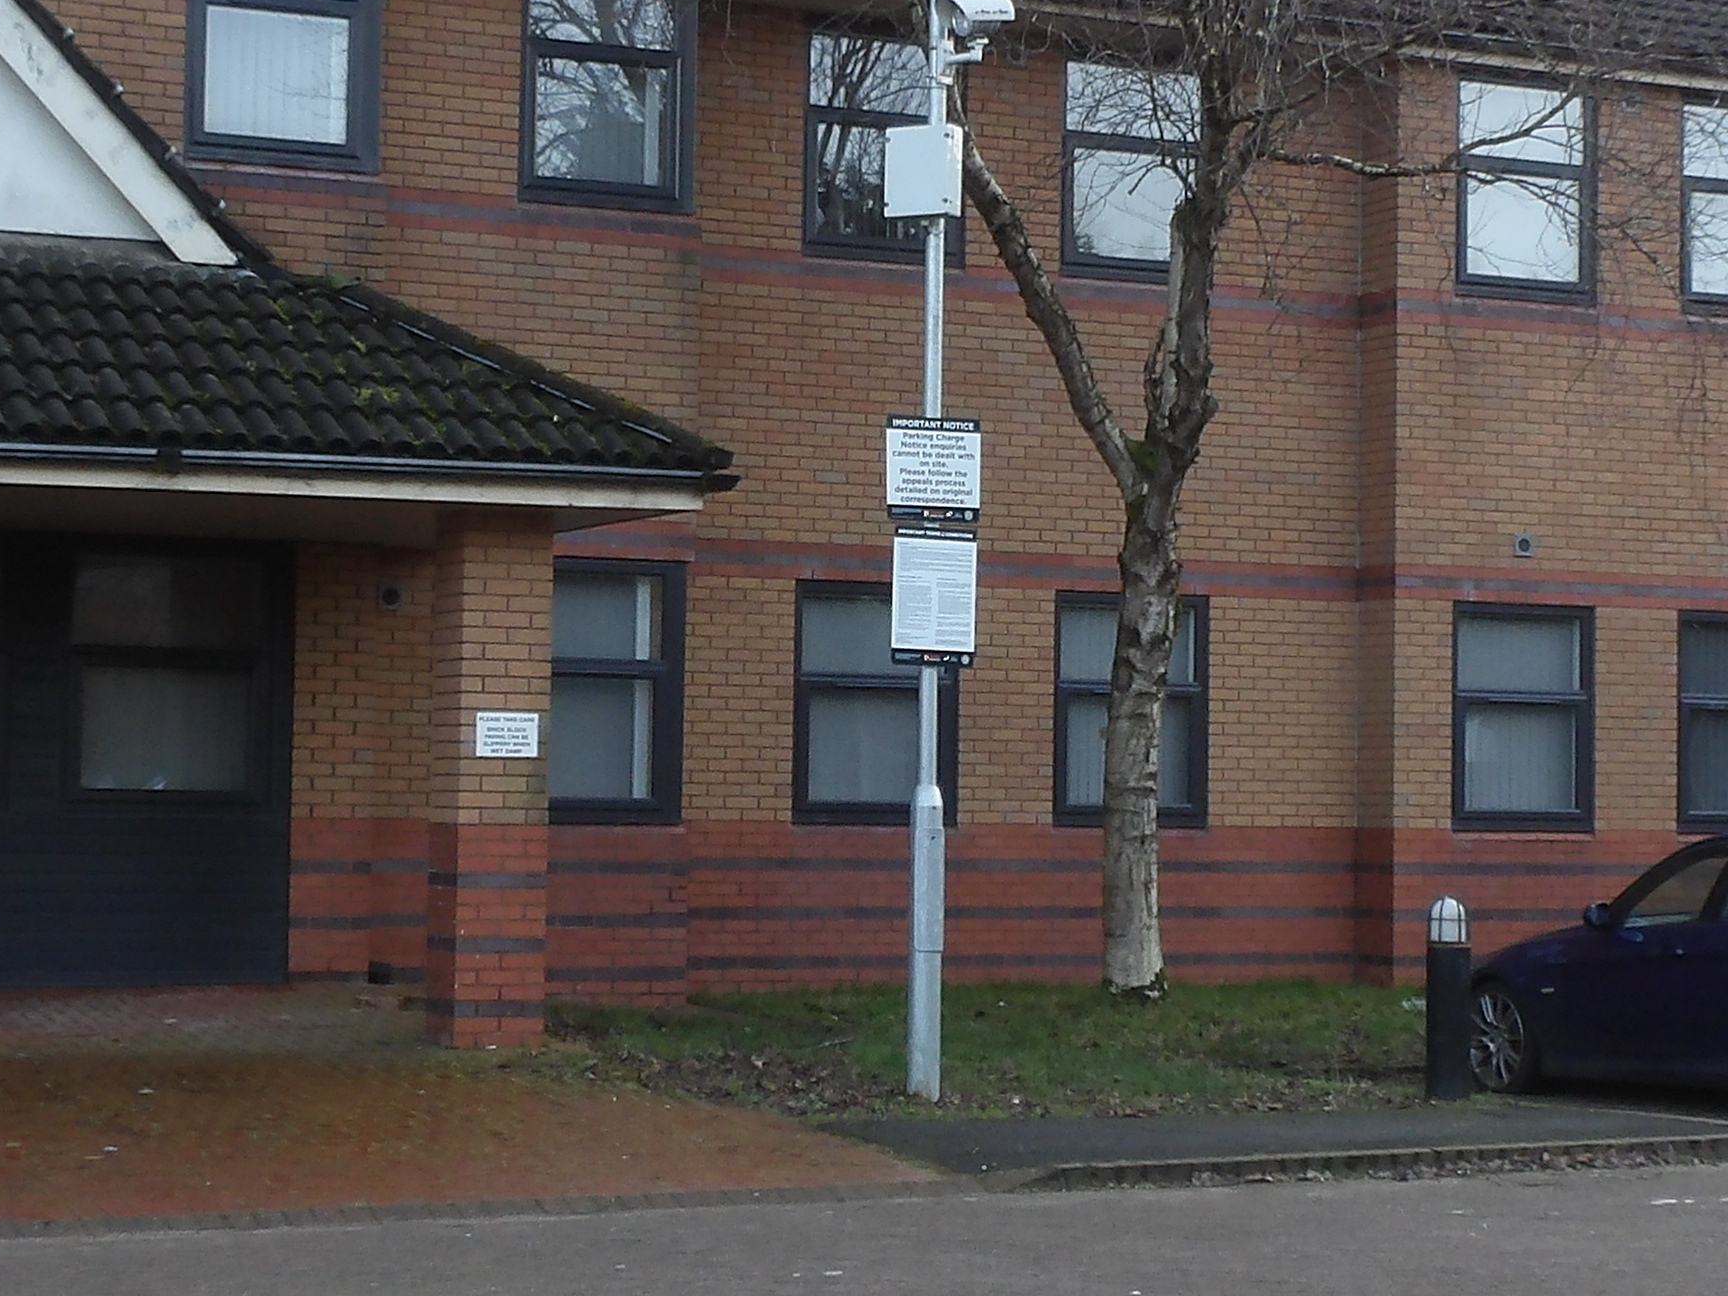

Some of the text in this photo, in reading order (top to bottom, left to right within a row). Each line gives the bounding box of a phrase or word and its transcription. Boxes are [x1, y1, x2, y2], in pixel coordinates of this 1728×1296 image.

[892, 419, 975, 431] IMPORTANT NOTICE
[903, 432, 965, 443] Parking Charge
[900, 441, 927, 449] Notice
[928, 469, 953, 477] follow
[955, 470, 967, 478] the
[902, 478, 933, 486] appeals
[894, 486, 928, 494] detailed
[942, 488, 972, 497] original
[900, 496, 967, 504] correspondence.
